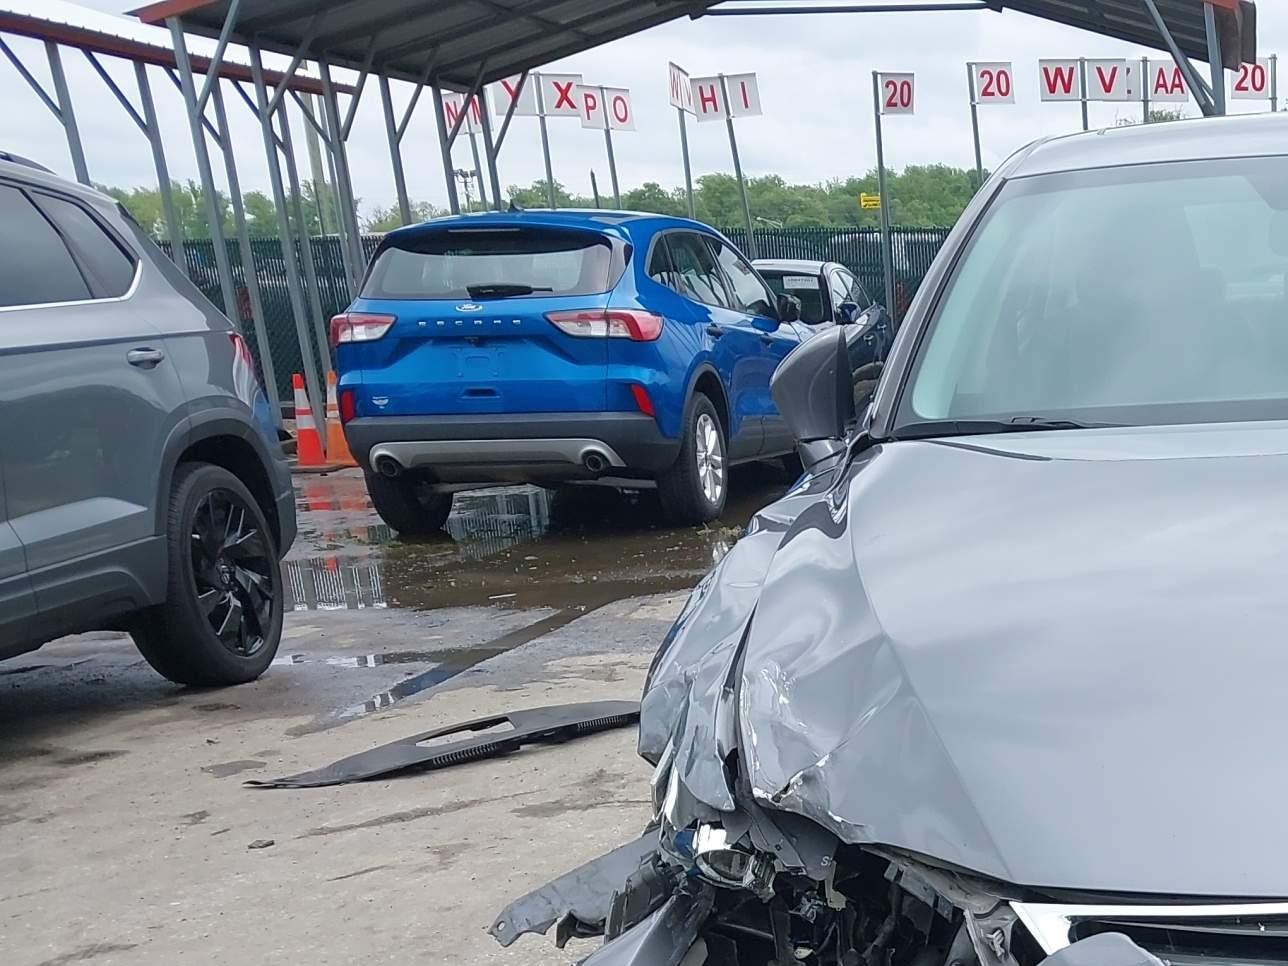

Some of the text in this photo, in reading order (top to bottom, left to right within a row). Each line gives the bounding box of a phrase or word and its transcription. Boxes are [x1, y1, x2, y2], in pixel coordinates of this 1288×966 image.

[979, 69, 1010, 97] 20
[1042, 66, 1074, 94] W
[1096, 66, 1118, 94] V
[1154, 67, 1185, 95] AA
[1234, 64, 1265, 92] 20
[552, 82, 577, 109] X
[583, 93, 597, 121] P
[698, 84, 718, 113] H
[740, 81, 749, 109] I
[884, 80, 911, 108] 20
